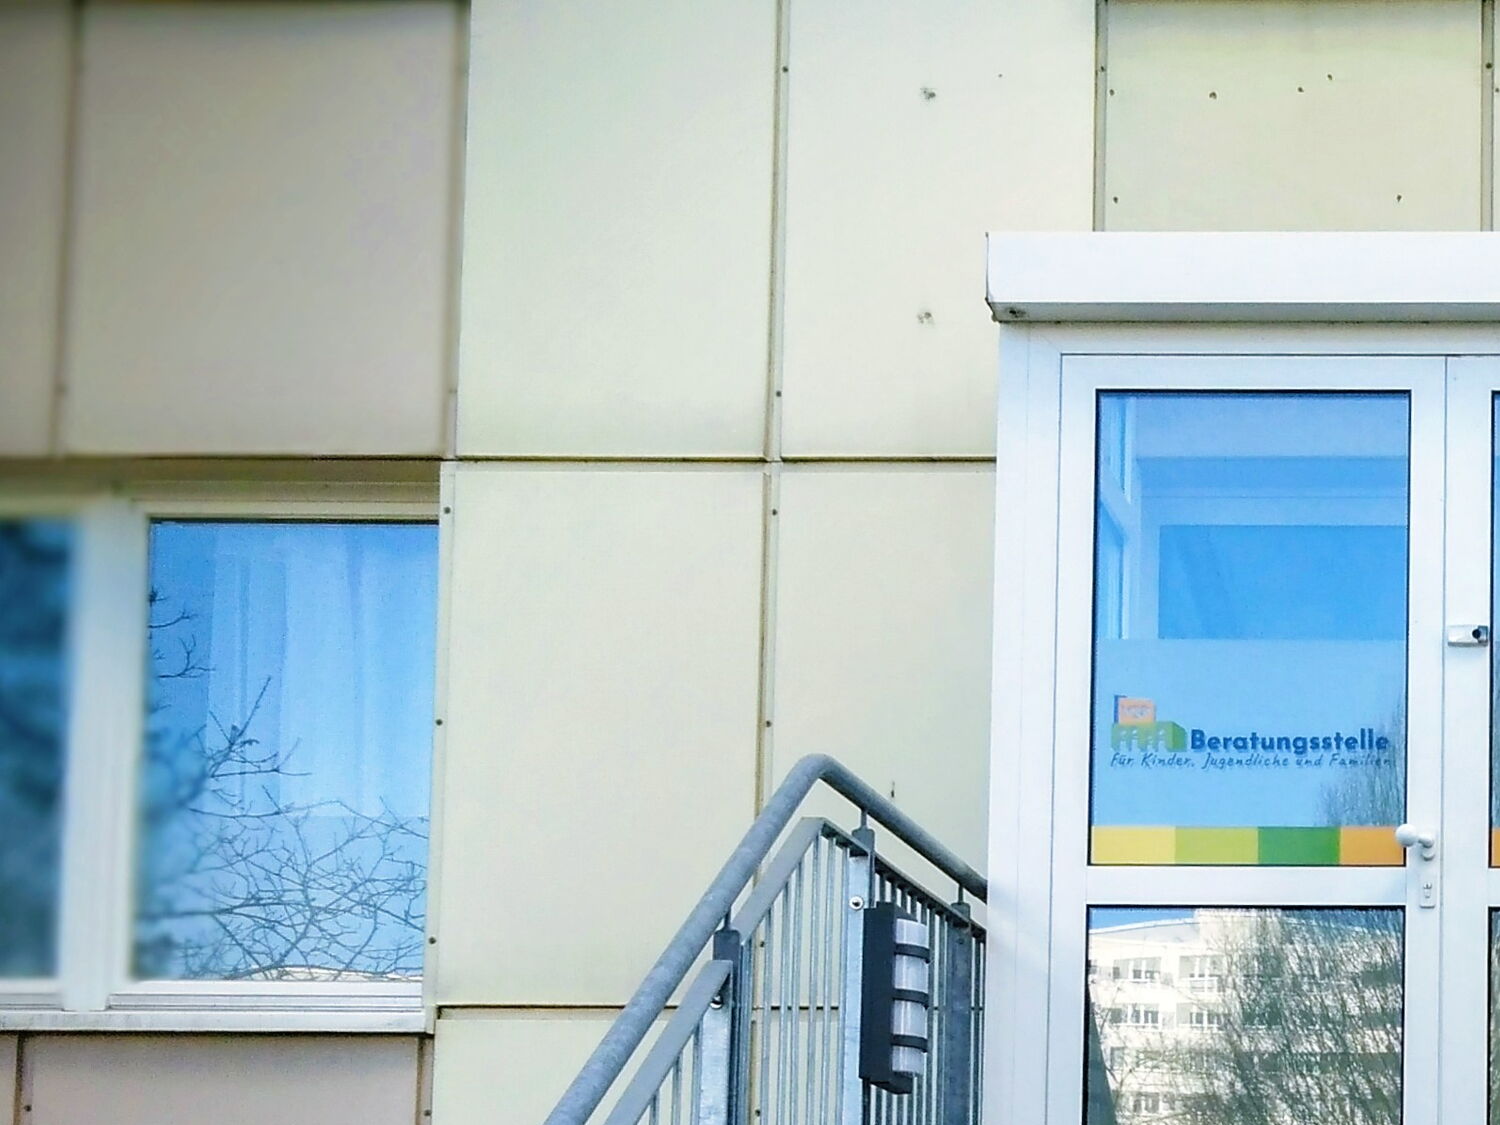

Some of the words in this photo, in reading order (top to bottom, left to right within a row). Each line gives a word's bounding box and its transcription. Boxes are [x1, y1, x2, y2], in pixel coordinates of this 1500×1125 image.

[1190, 728, 1390, 756] Beratungsstelle
[1201, 753, 1289, 770] Jugendliche
[1296, 754, 1323, 767] und
